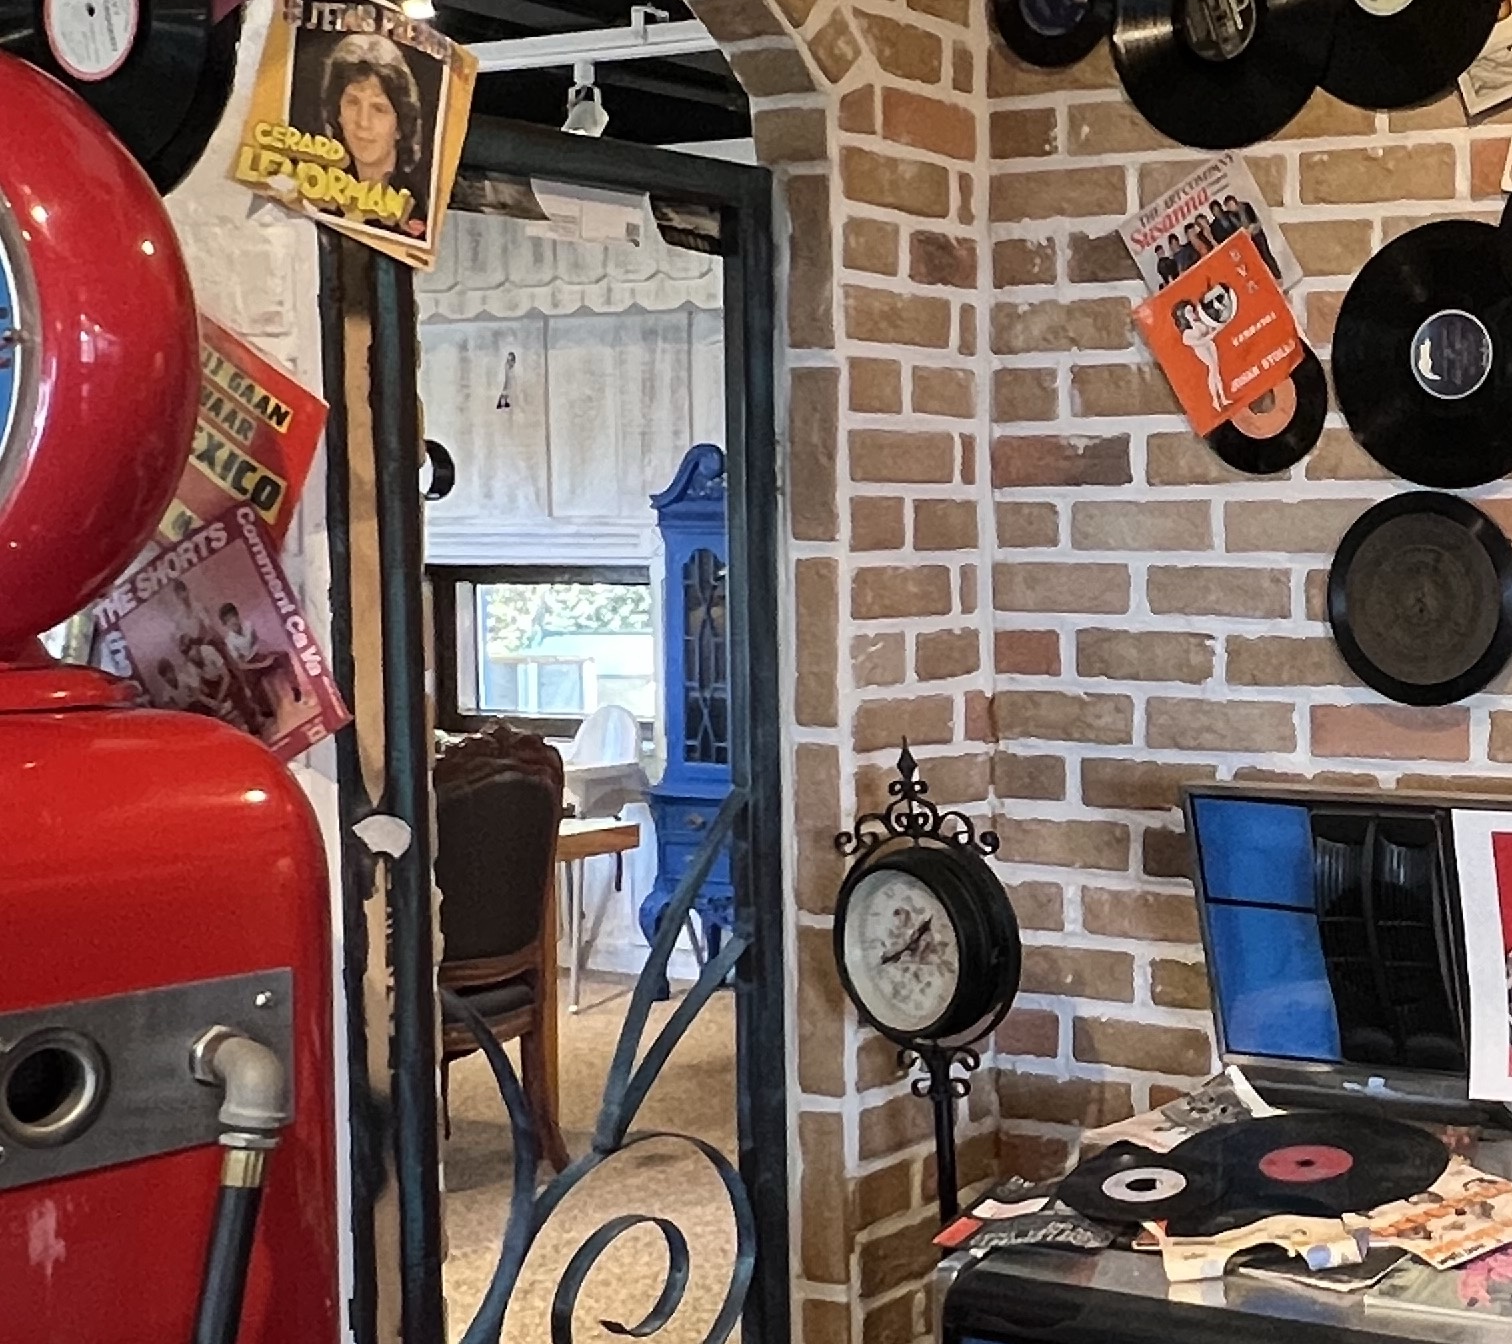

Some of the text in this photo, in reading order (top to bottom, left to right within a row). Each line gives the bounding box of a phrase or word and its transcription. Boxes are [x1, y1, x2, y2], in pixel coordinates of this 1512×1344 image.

[1130, 186, 1211, 253] Susanna
[228, 370, 290, 429] GAAN
[92, 582, 137, 630] THE
[135, 521, 229, 601] SHORTS
[236, 506, 323, 678] Comment Ca Va
